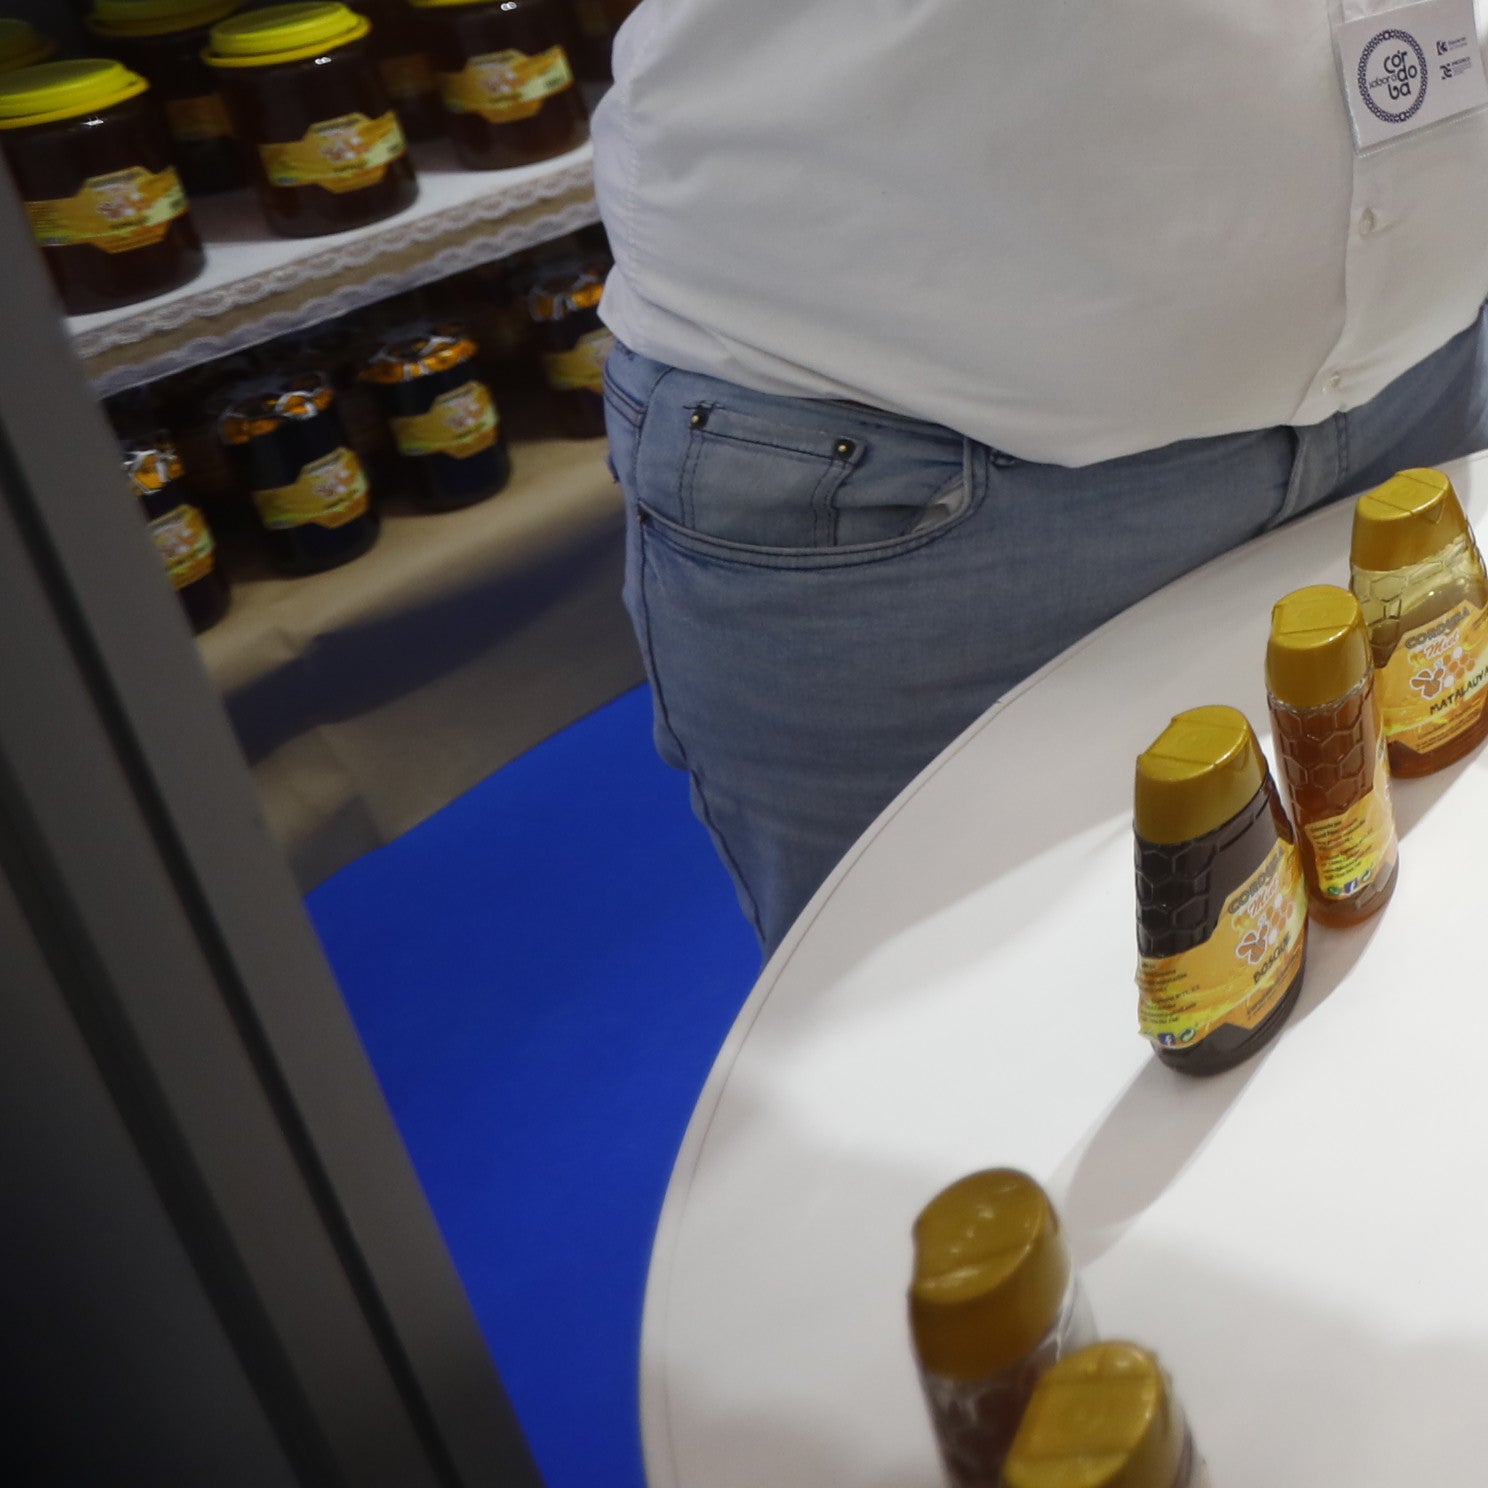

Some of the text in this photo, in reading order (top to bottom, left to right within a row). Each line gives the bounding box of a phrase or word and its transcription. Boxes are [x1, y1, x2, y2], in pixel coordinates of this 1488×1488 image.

[1405, 607, 1471, 649] CORDUBA
[1425, 629, 1460, 660] Miel
[1228, 847, 1284, 914] CORDUBA
[1249, 874, 1279, 917] Miel
